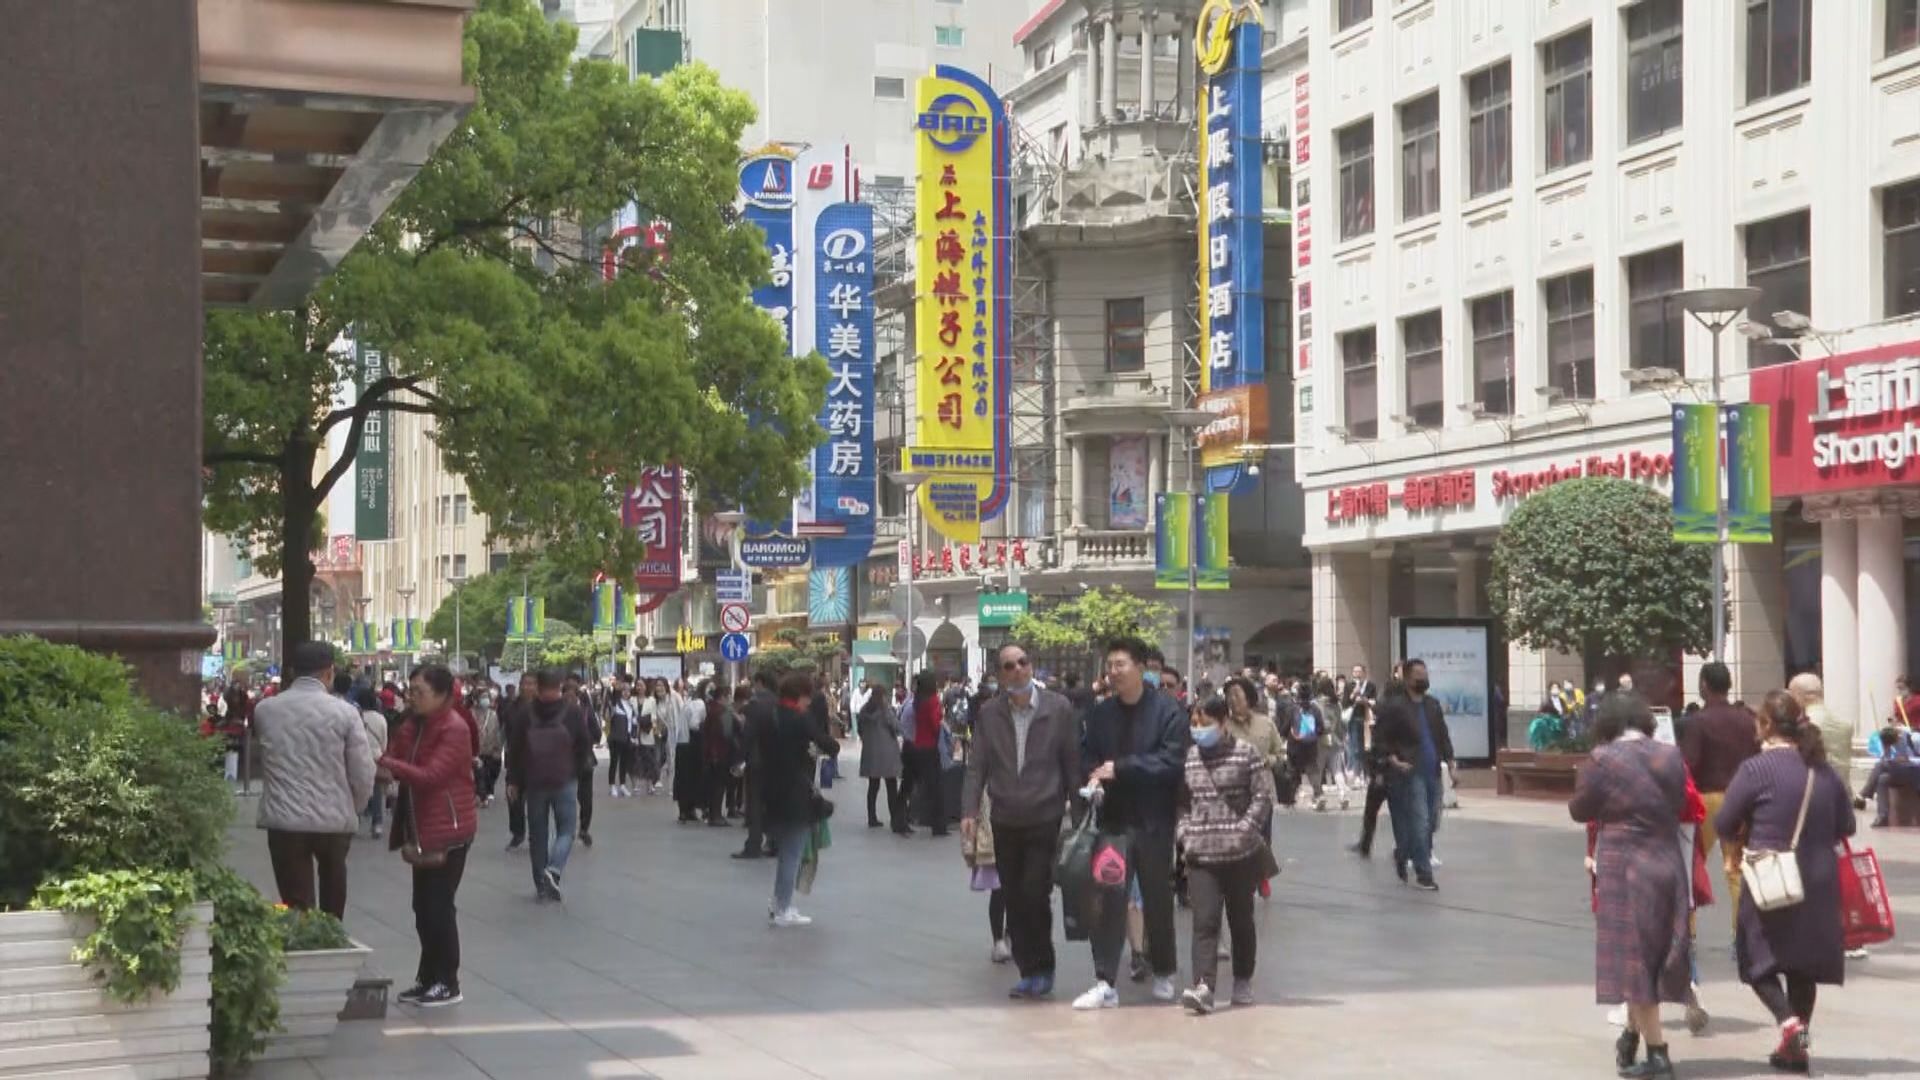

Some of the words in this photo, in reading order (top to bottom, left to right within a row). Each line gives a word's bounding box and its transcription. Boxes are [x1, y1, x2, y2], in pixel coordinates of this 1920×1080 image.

[828, 281, 862, 475] 华美大药房
[743, 543, 806, 553] BAROMON
[639, 562, 672, 574] PTICAL
